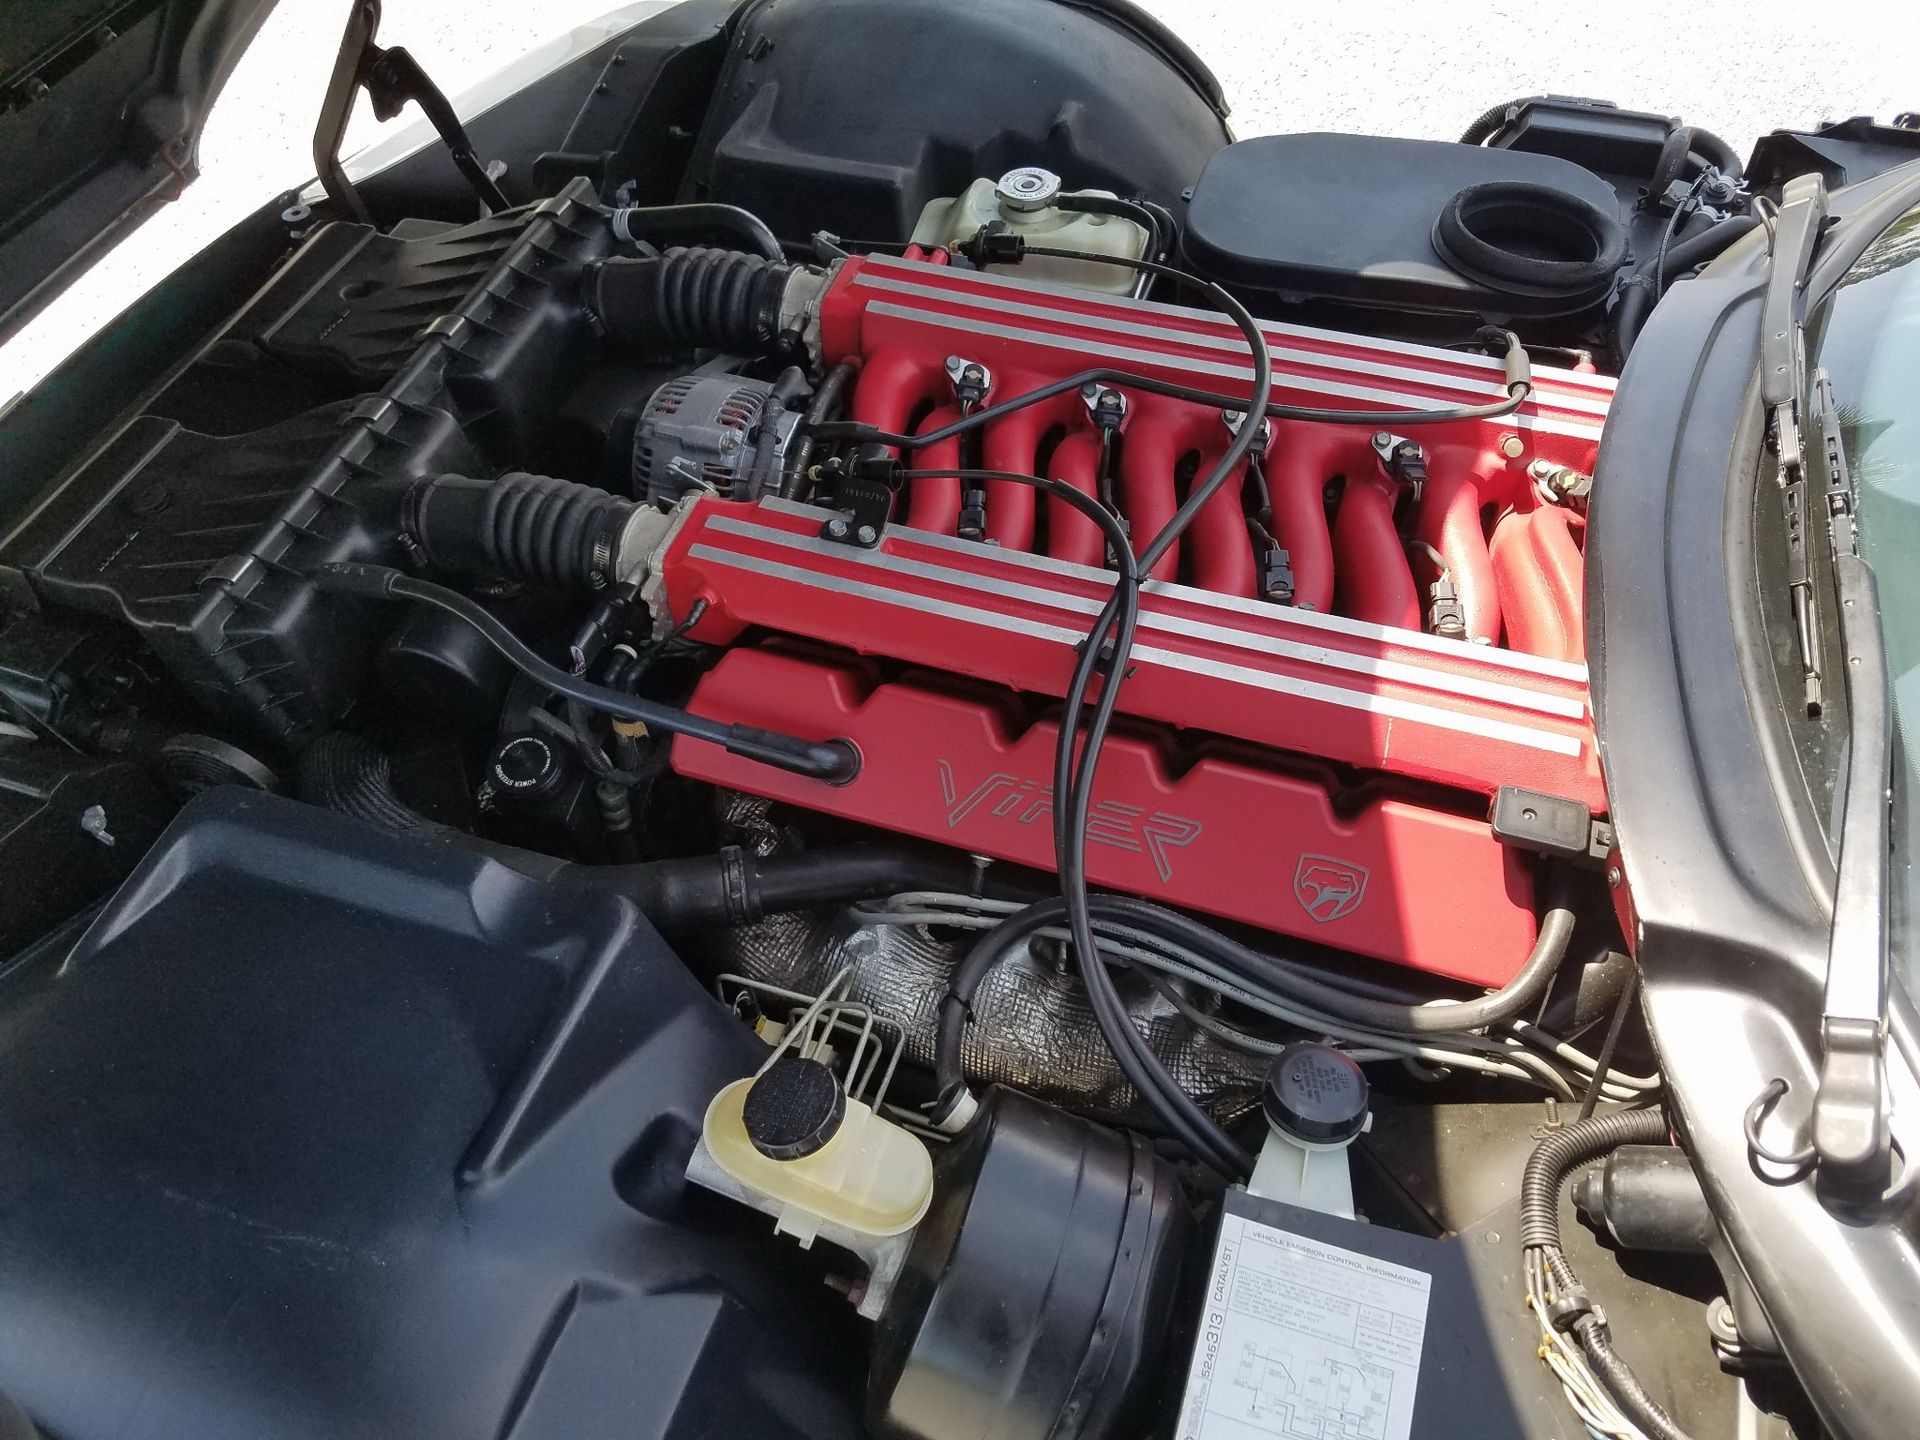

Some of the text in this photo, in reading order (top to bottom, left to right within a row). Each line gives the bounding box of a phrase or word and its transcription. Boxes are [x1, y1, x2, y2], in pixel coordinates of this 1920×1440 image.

[495, 764, 536, 788] POWER STEERING
[1252, 1231, 1285, 1246] VEHICLE
[1286, 1241, 1326, 1259] EMISSION
[1326, 1254, 1364, 1270] CONTROL
[1366, 1265, 1422, 1287] INFORMATION
[1201, 1245, 1233, 1378] 5245313 CATALYST
